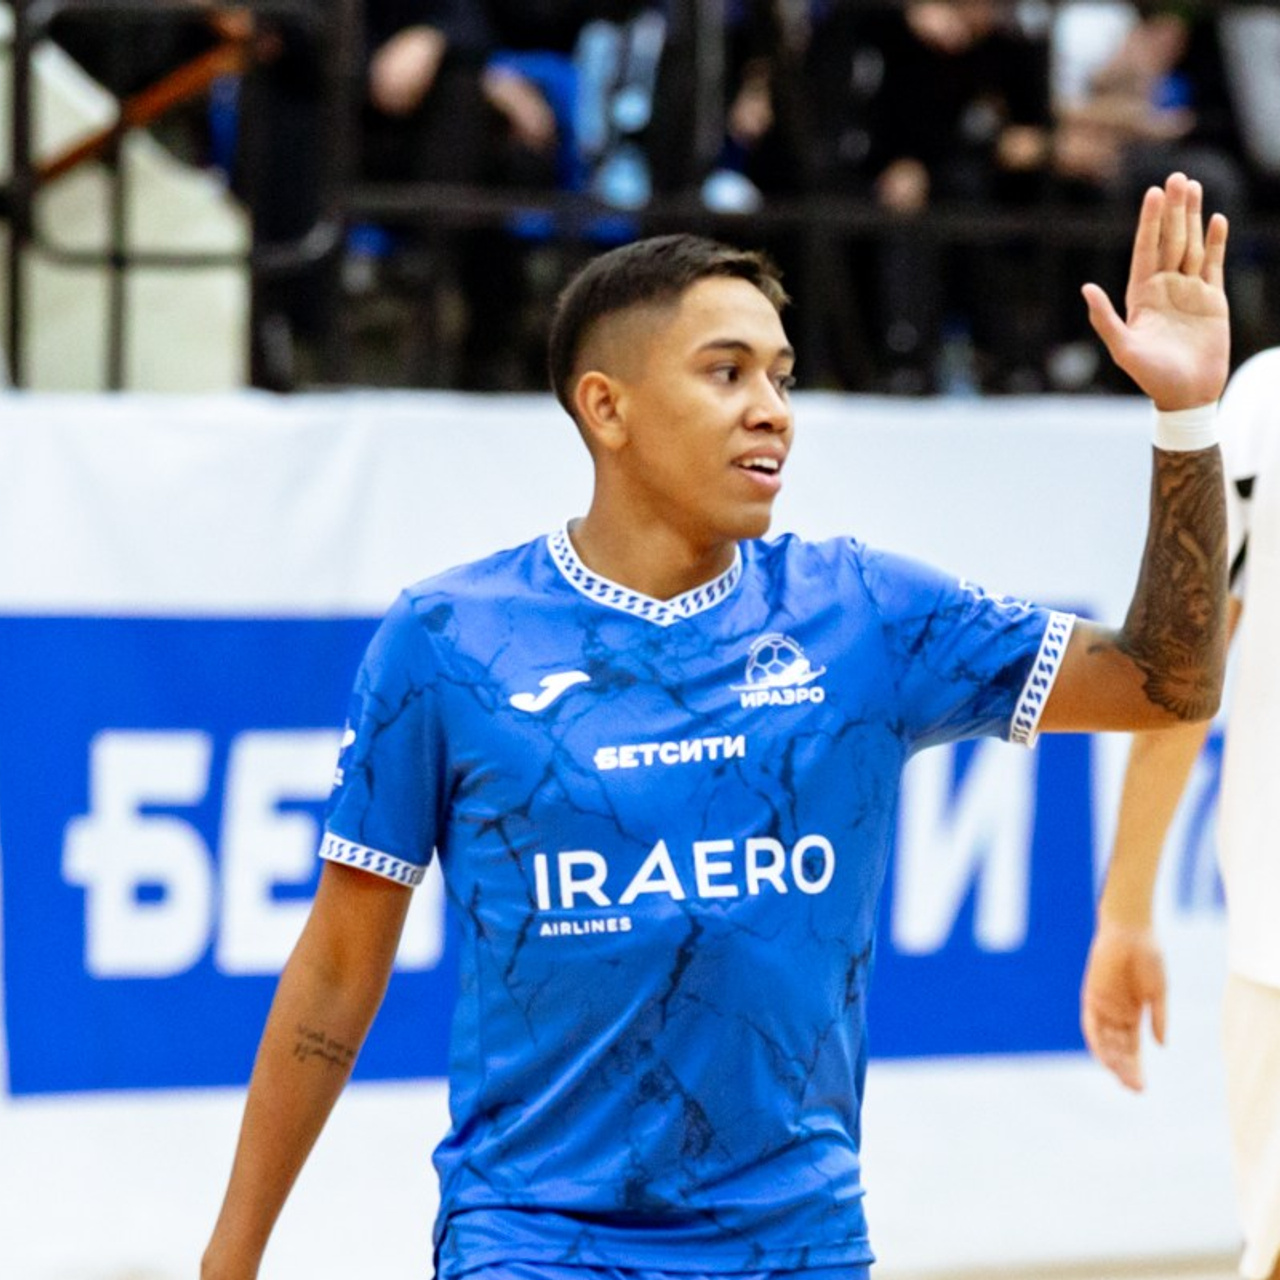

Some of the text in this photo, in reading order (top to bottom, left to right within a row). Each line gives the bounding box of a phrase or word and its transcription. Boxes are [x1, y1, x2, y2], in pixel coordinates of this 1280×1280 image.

[741, 686, 826, 708] ИРАЭРО
[594, 734, 746, 770] БЕТСИТИ
[534, 834, 836, 910] IRAERO
[539, 916, 632, 937] AIRLINES
